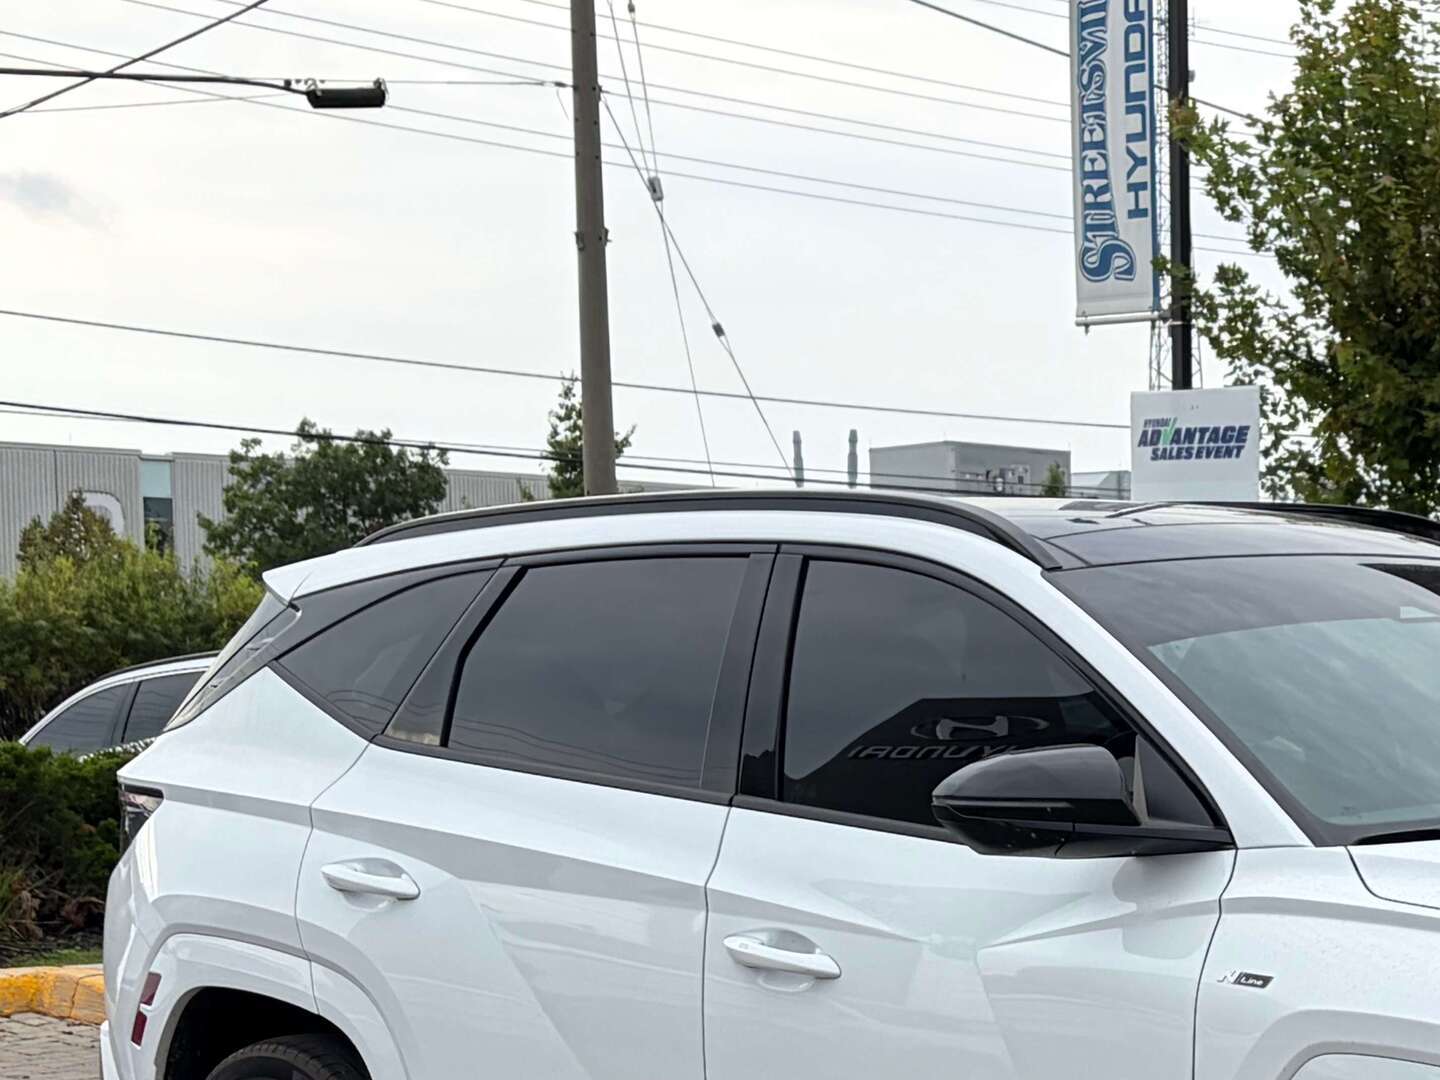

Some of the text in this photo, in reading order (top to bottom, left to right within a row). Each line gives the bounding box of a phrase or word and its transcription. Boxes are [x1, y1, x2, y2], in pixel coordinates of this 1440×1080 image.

[1138, 419, 1251, 447] ADVANTAGE
[1150, 445, 1245, 461] SALES EVENT
